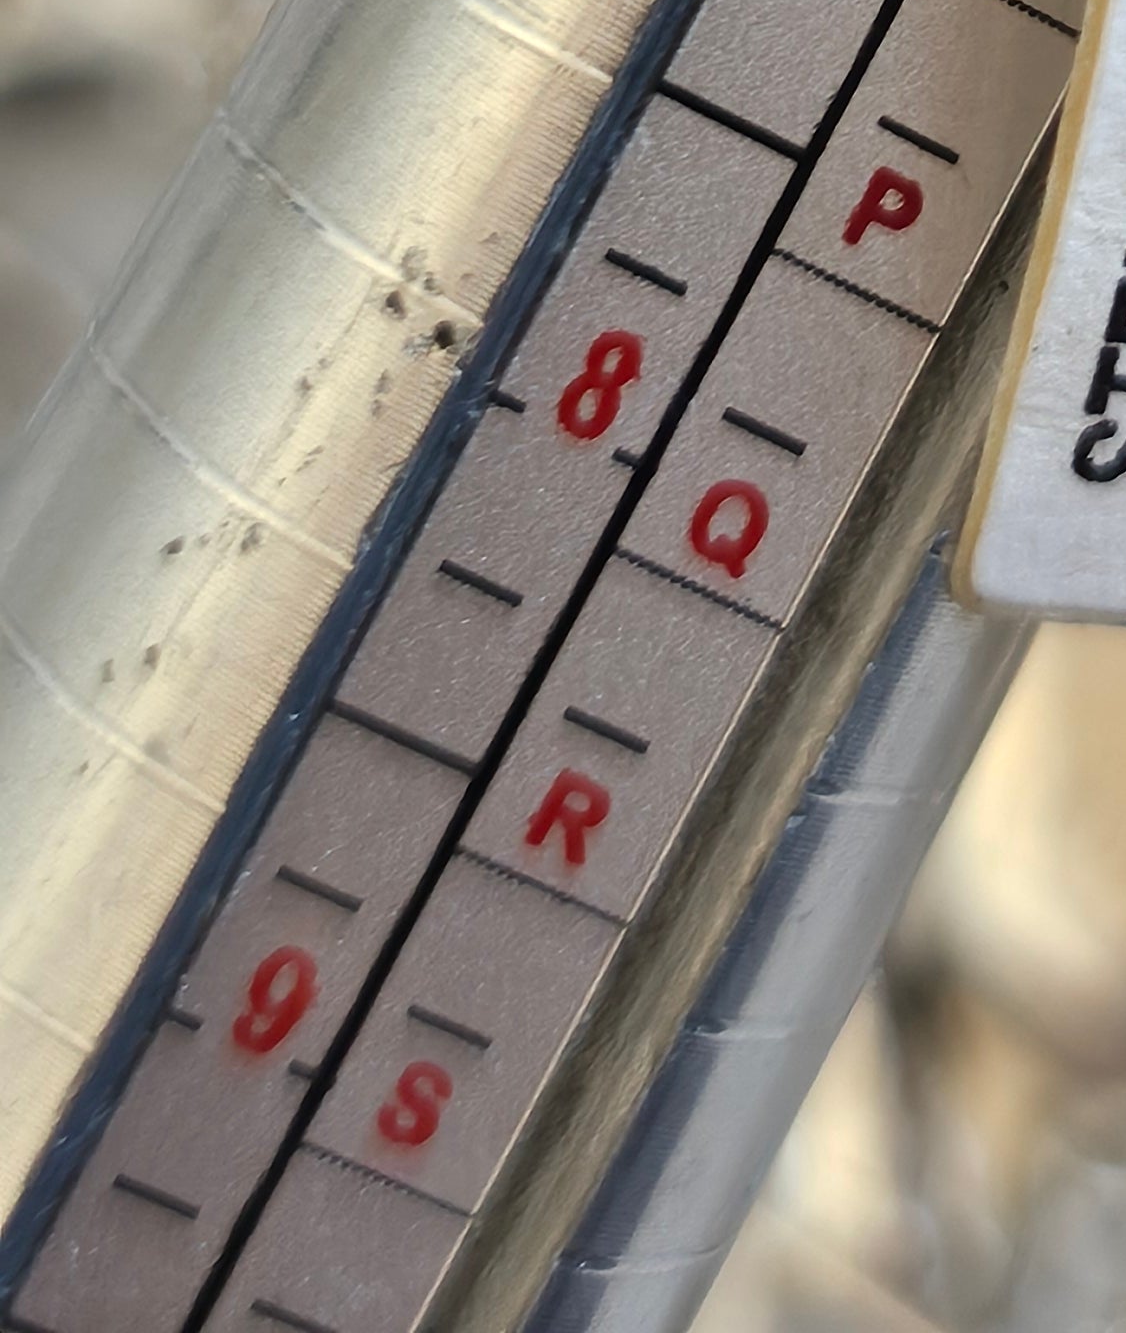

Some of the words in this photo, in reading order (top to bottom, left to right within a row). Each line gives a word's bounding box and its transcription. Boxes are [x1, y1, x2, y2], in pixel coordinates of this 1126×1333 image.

[842, 166, 924, 246] P
[555, 328, 643, 443] 8
[686, 479, 770, 580] Q
[523, 767, 612, 867] R
[231, 945, 318, 1057] 9
[376, 1060, 453, 1149] S
